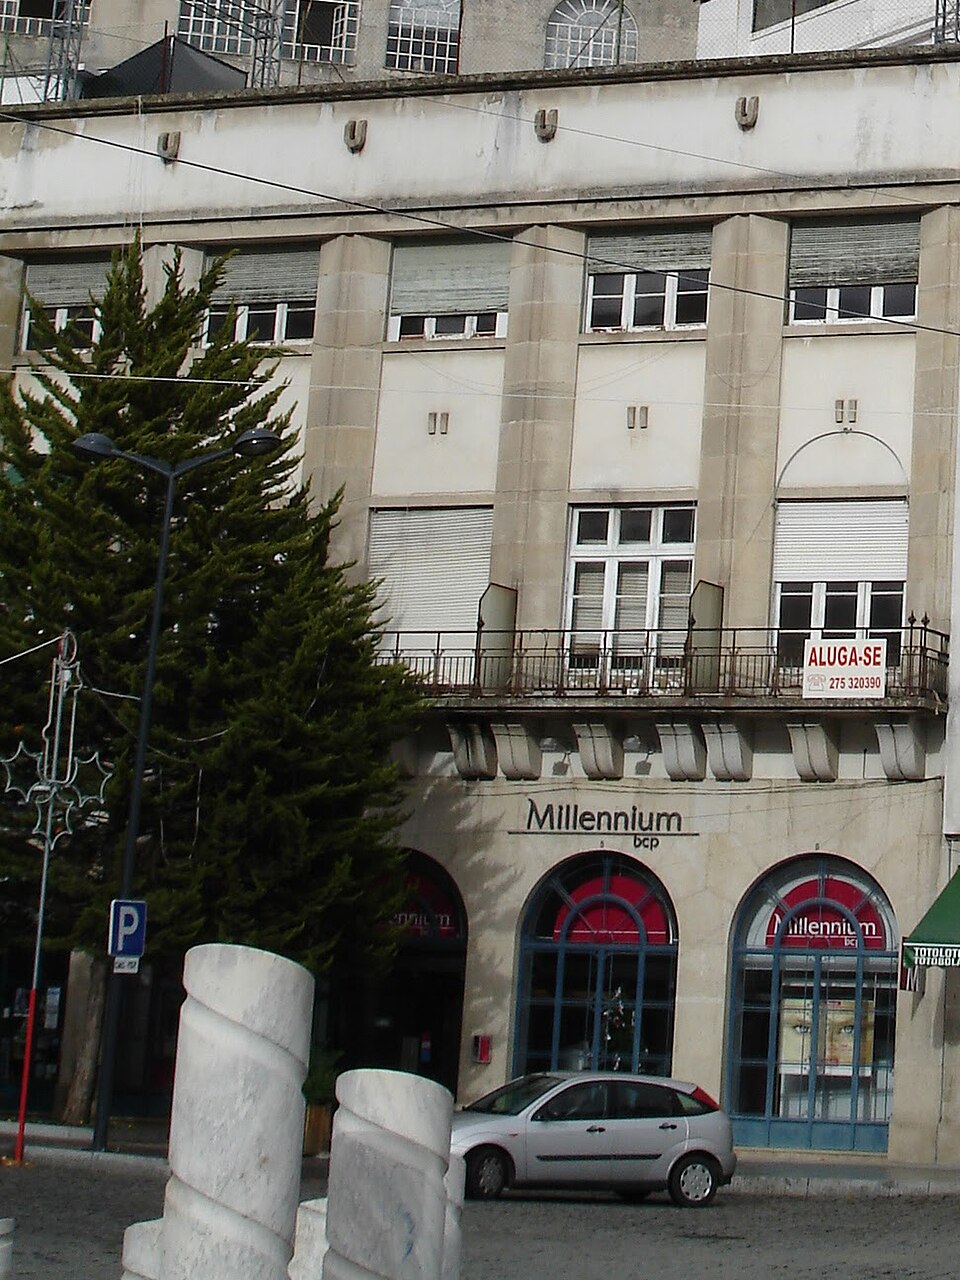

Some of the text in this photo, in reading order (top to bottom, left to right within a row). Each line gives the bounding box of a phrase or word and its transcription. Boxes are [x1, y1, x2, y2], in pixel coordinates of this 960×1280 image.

[808, 646, 882, 667] ALUGA-SE
[829, 676, 881, 690] 275 320390
[527, 798, 683, 832] Millennium
[633, 834, 660, 850] bcp
[117, 906, 139, 951] P
